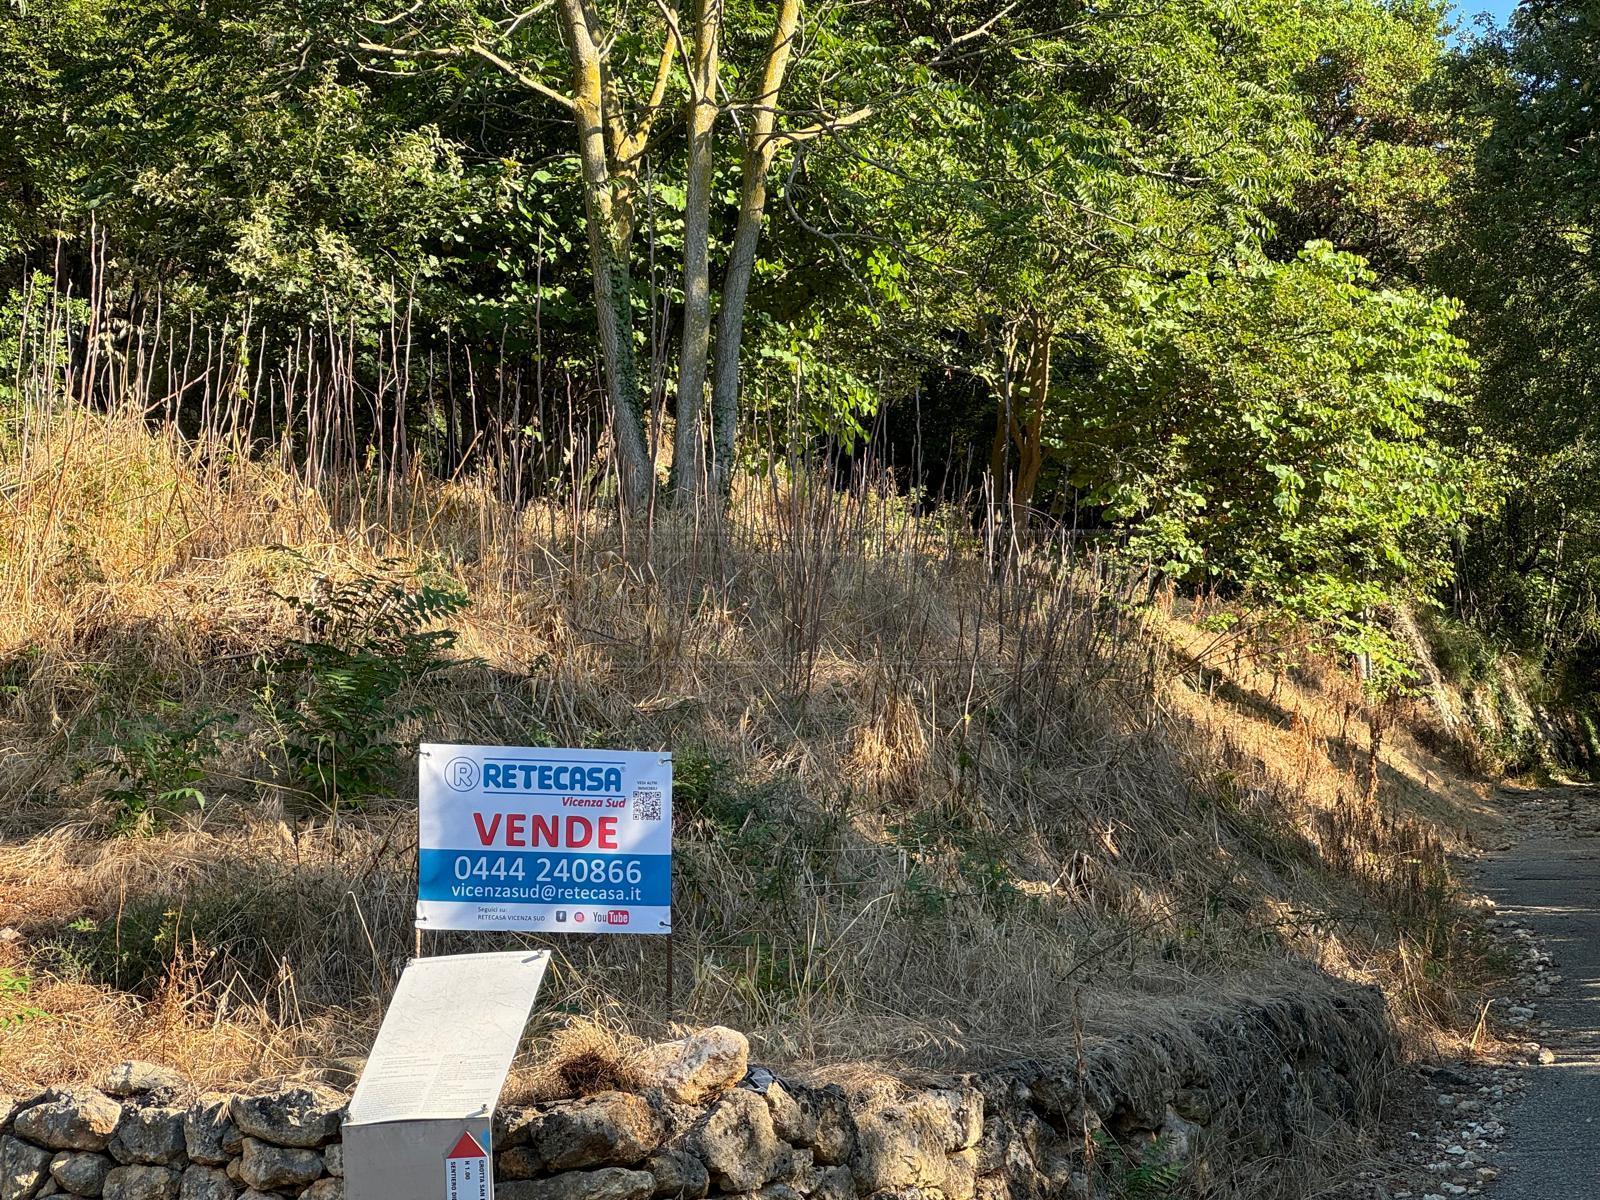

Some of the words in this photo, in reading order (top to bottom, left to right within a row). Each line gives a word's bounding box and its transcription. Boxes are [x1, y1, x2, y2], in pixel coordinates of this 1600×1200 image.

[483, 763, 622, 793] RETECASA
[562, 796, 603, 808] Vicenza
[605, 798, 627, 808] Sud
[473, 812, 618, 849] VENDE
[454, 855, 526, 881] 0444
[536, 857, 642, 884] 240866
[451, 882, 642, 901] vicenzasud@retecasa.it
[593, 910, 629, 923] YouTube
